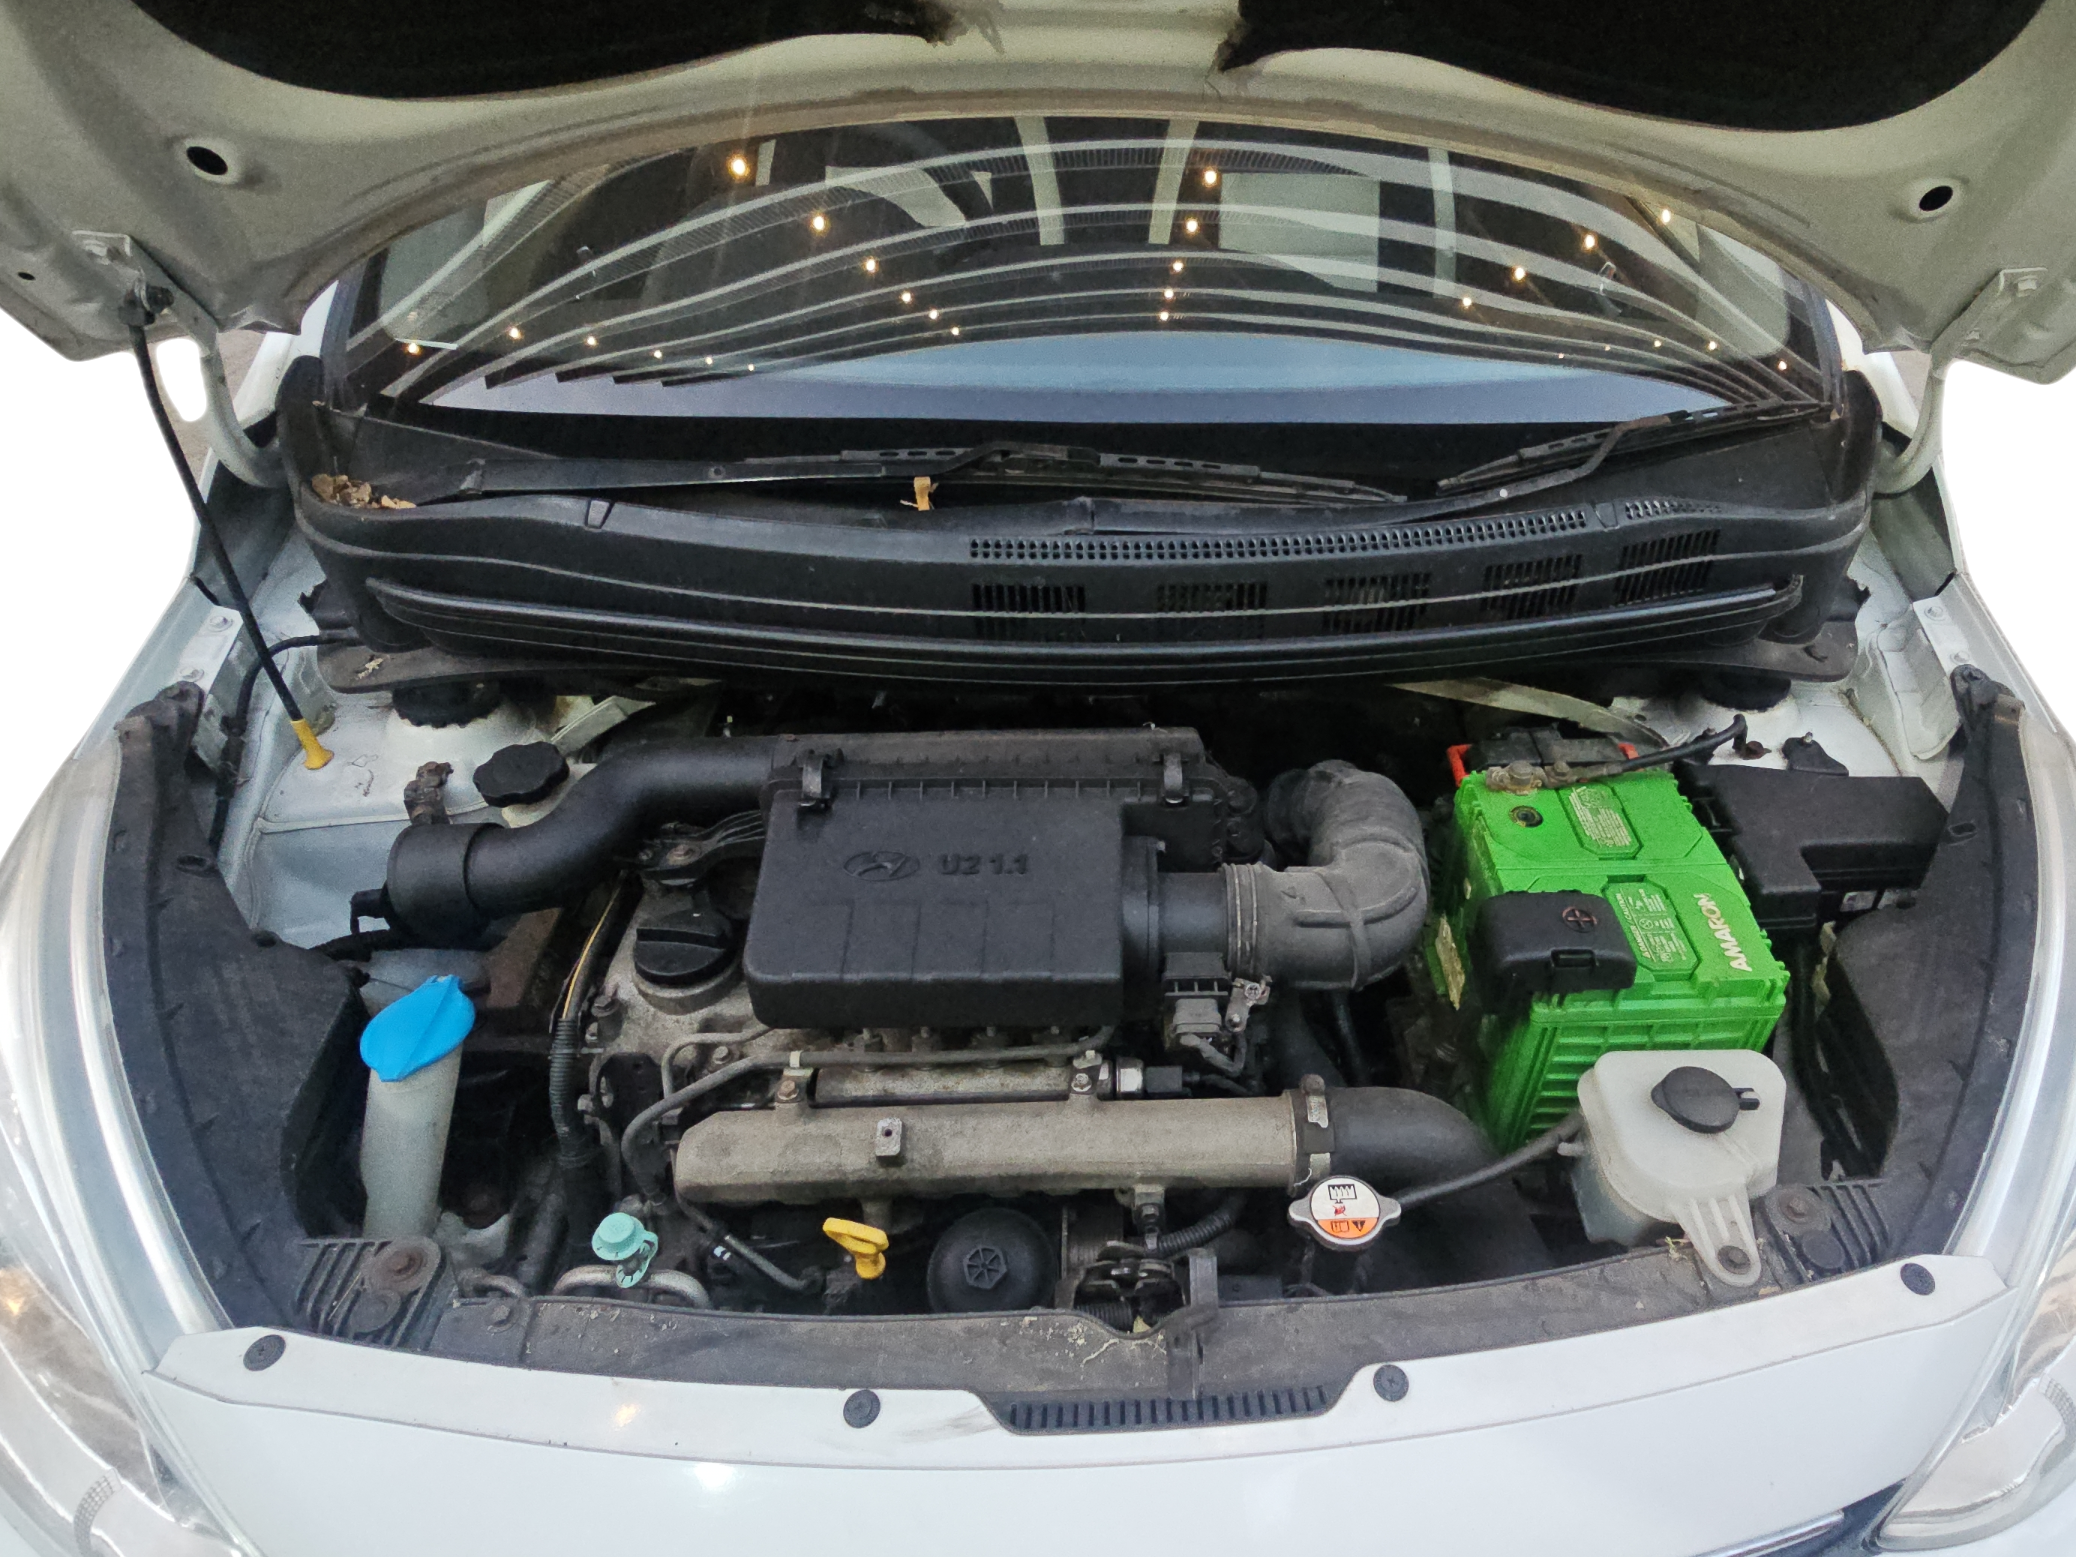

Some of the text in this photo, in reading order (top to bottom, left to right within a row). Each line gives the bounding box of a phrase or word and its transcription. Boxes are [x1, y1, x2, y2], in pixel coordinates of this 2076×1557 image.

[939, 853, 1029, 876] U2 1.1
[1693, 893, 1753, 972] AMARON
